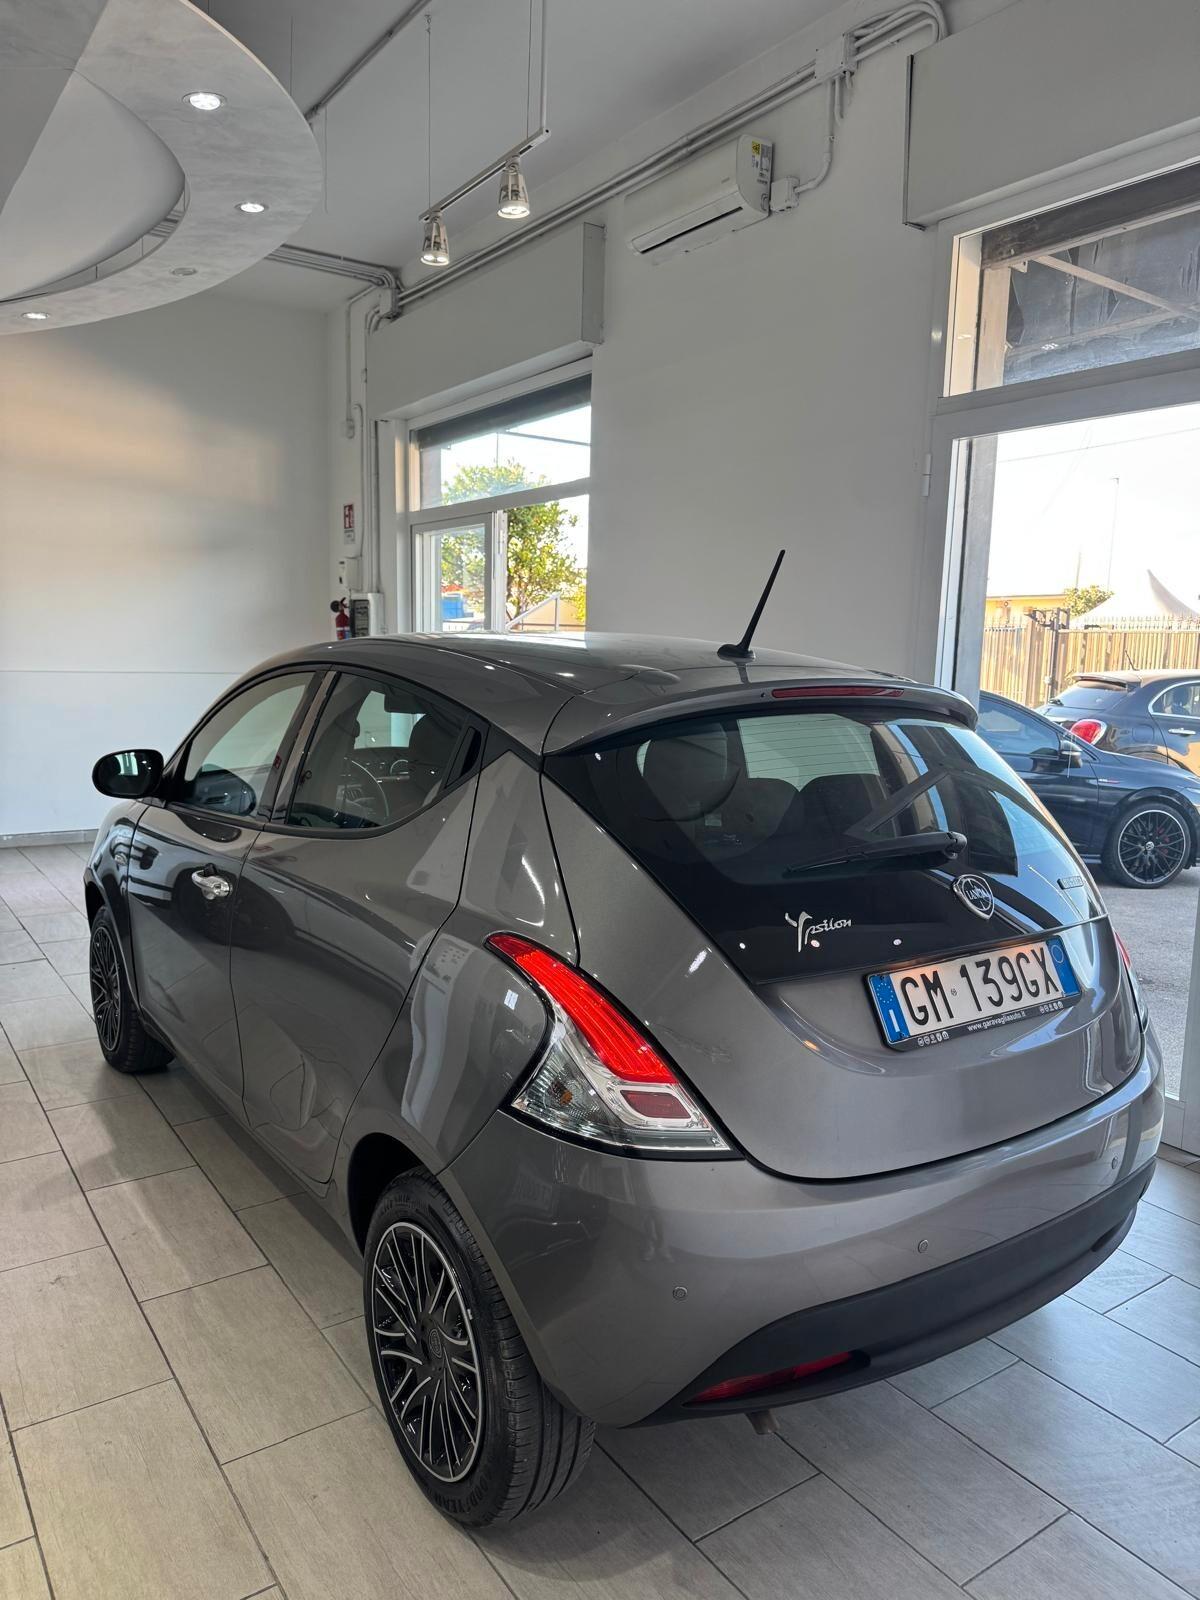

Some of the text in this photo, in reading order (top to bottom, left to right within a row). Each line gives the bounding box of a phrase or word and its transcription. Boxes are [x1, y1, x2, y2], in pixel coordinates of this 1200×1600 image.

[784, 911, 852, 953] Ypsilon
[900, 947, 1059, 1026] GM 139GX
